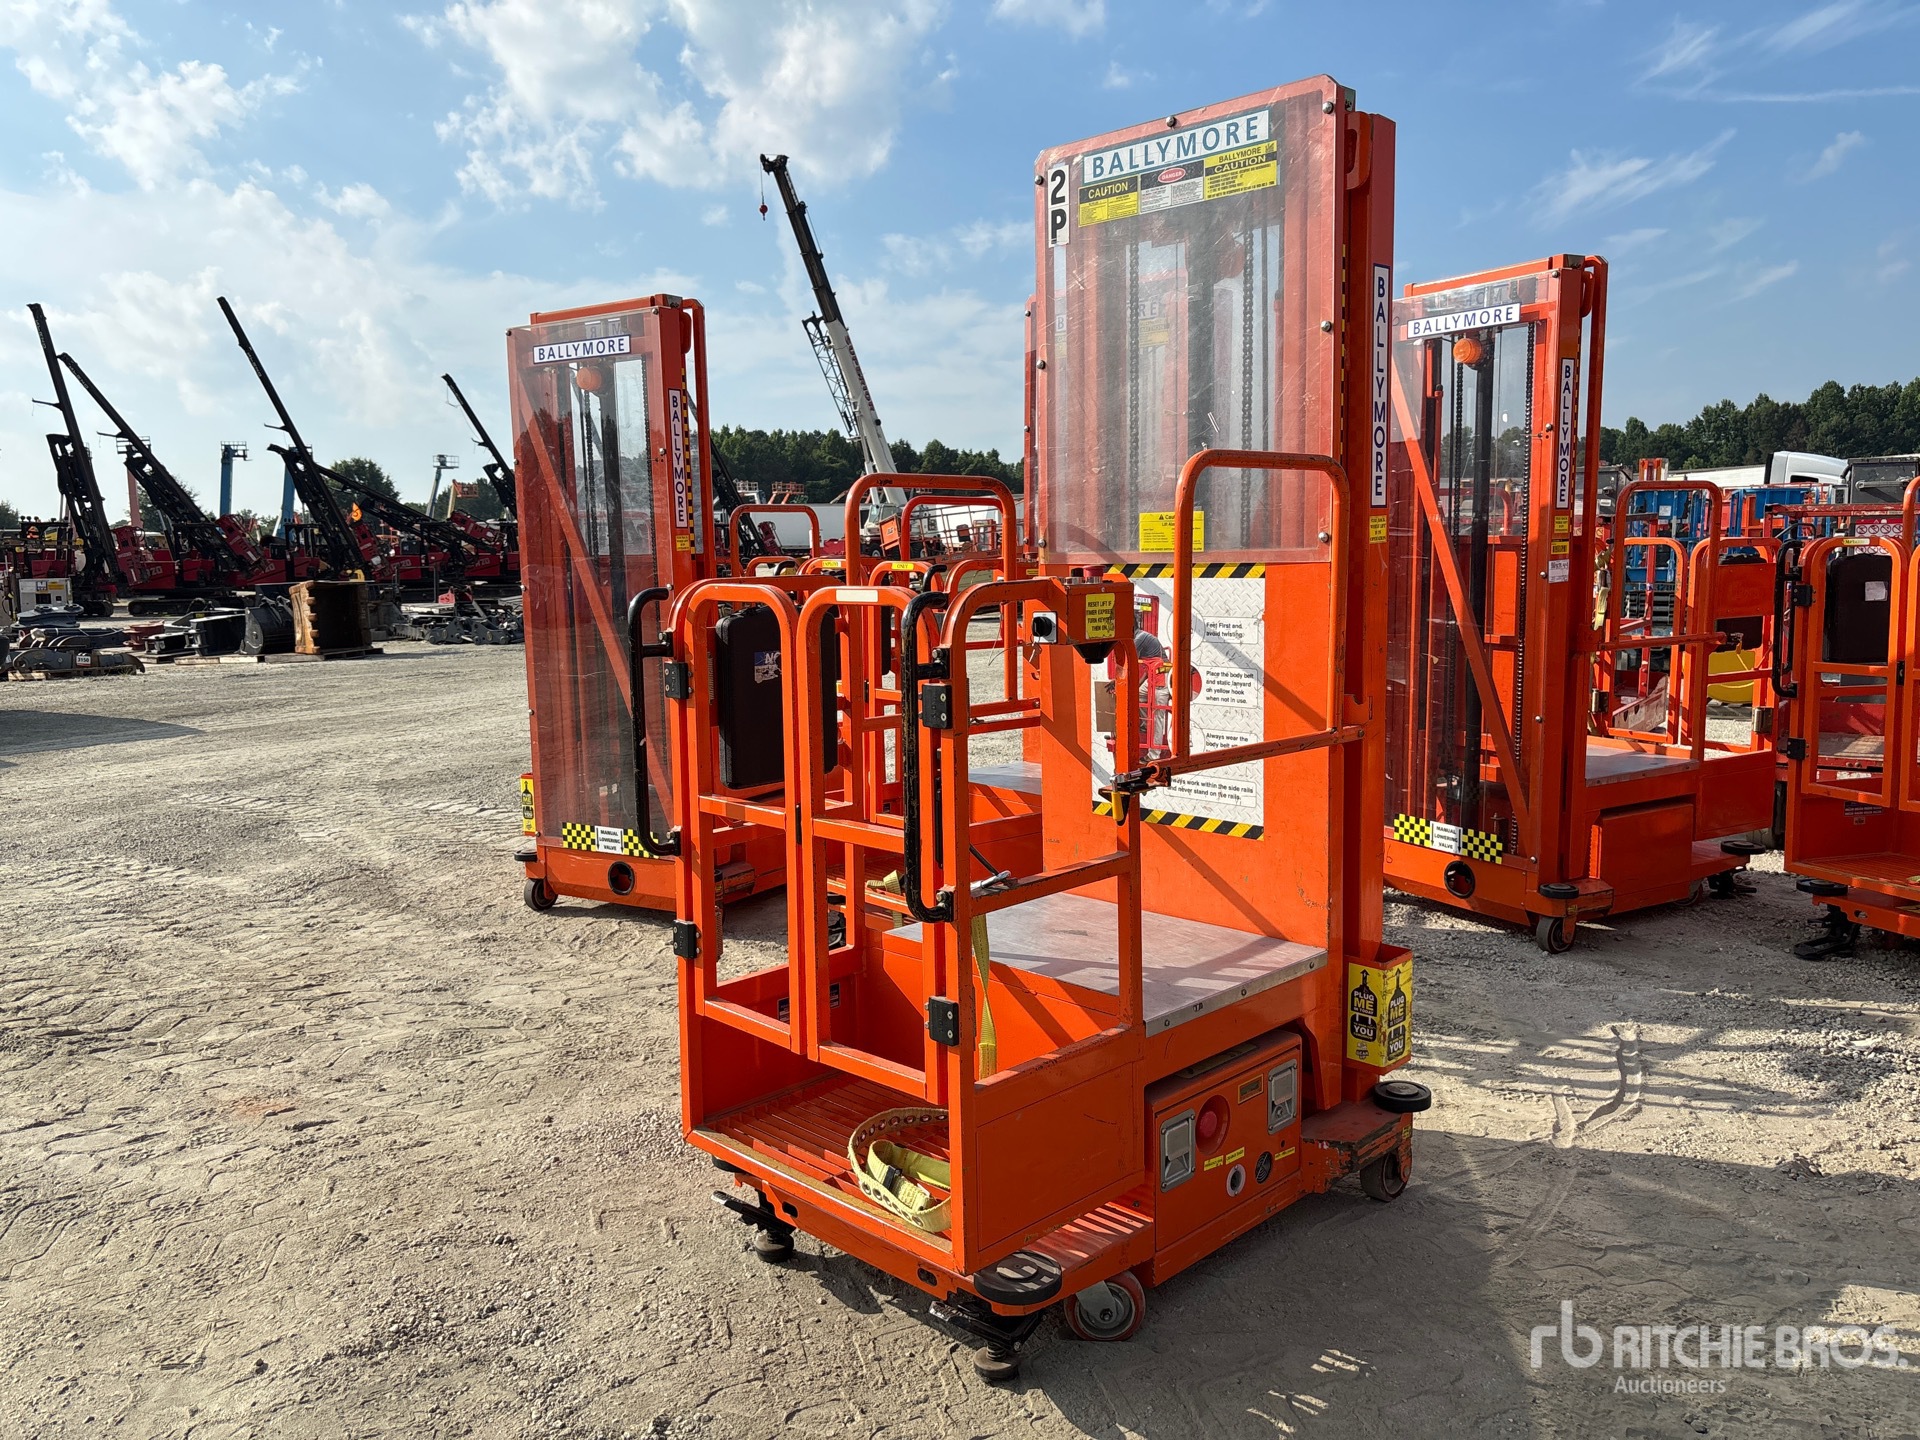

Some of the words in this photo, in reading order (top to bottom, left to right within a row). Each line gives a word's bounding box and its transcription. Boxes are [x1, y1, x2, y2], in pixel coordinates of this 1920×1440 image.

[1092, 116, 1258, 178] BALLYMORE
[1218, 147, 1262, 163] BALLYMORE
[1214, 155, 1266, 173] CAUTION
[1162, 170, 1183, 180] DANGER
[1050, 170, 1066, 206] 2
[1088, 182, 1128, 199] CAUTION
[1051, 208, 1066, 244] P
[1414, 306, 1513, 335] BALLYMORE
[538, 338, 624, 360] BALLYMORE
[1374, 276, 1386, 496] BALLYMORE
[1559, 365, 1571, 502] BALLYMORE
[672, 396, 684, 522] BALLYMORE
[1434, 834, 1458, 842] LOWERING
[1436, 826, 1456, 834] MANUAL
[1354, 990, 1374, 1001] PLUG
[1390, 996, 1404, 1008] PLUG
[1354, 998, 1374, 1011] ME
[1390, 1004, 1404, 1019] ME
[1354, 1025, 1373, 1037] YOU
[1390, 1040, 1403, 1053] YOU
